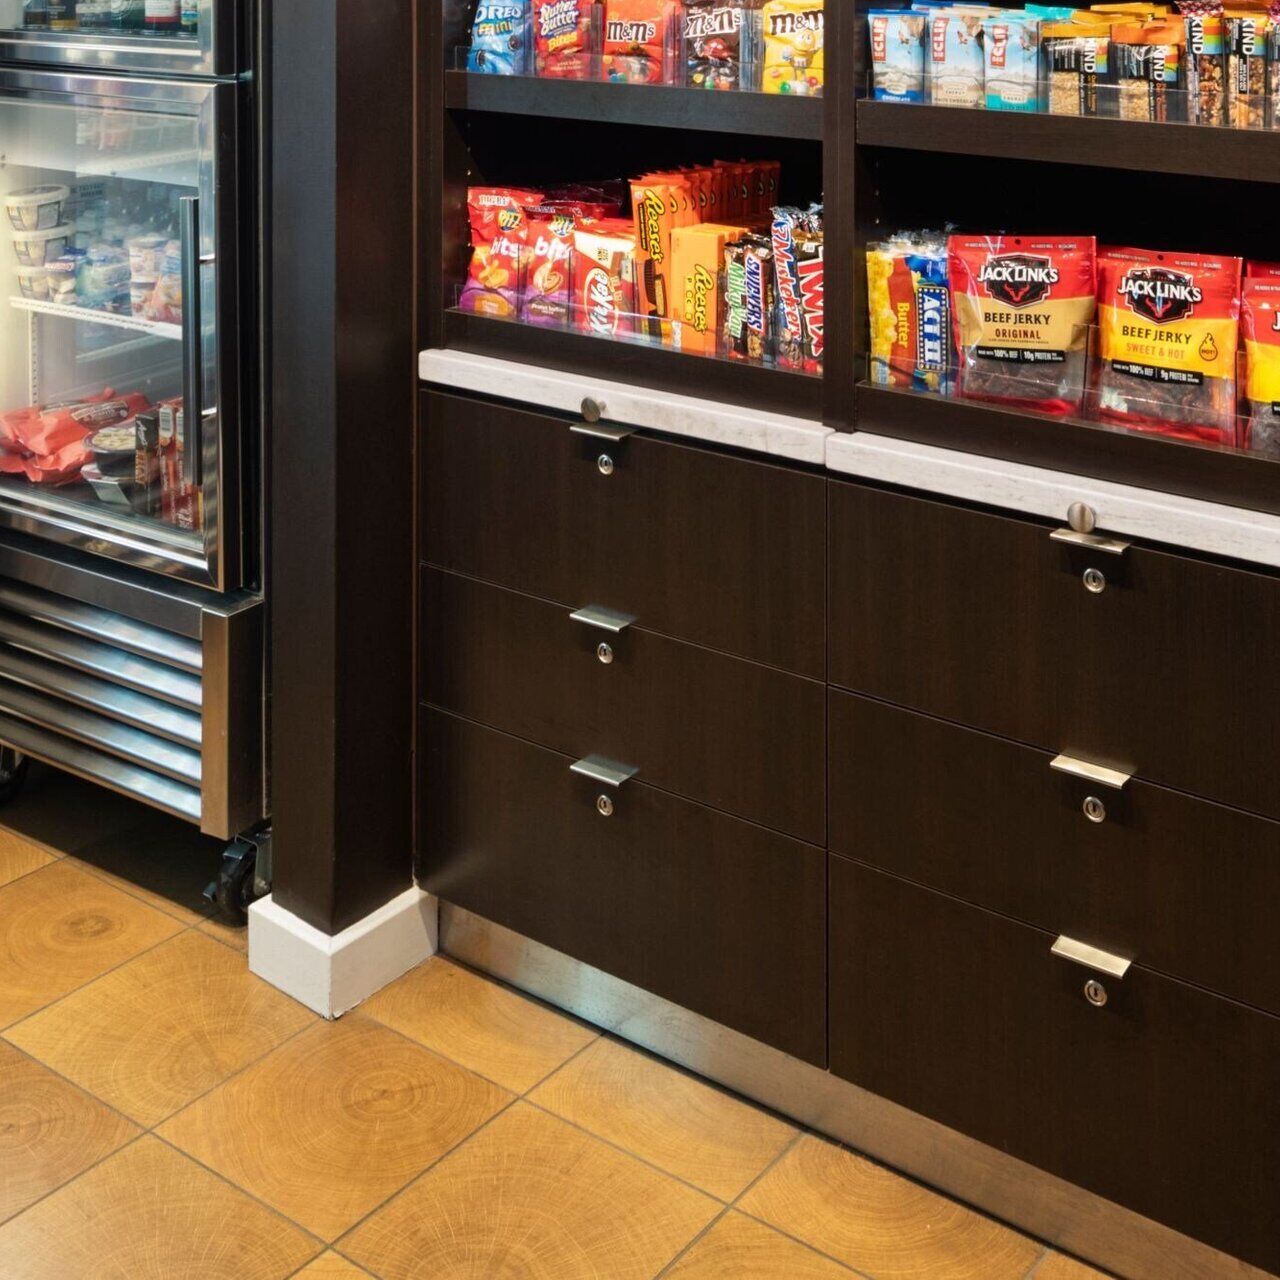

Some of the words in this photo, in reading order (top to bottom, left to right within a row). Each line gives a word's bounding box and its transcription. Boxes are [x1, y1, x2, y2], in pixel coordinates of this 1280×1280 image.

[475, 5, 522, 24] OREO
[539, 0, 578, 21] Nutter
[477, 21, 513, 36] mini
[539, 11, 579, 36] Butter
[1191, 16, 1204, 55] KIND
[1243, 18, 1256, 56] KIND
[1085, 39, 1097, 73] KIND
[1154, 45, 1165, 81] KIND
[644, 189, 665, 264] Reese's
[491, 237, 519, 256] bits
[534, 236, 573, 258] bits
[977, 265, 1014, 282] JACK
[1014, 265, 1059, 284] LINK'S
[694, 264, 714, 335] Reese's
[746, 254, 763, 333] SNICKERS
[773, 237, 803, 342] Musketeers
[1118, 277, 1155, 297] JACK
[1156, 281, 1202, 302] LINK'S
[897, 302, 910, 348] Butter
[984, 312, 1011, 323] BEEF
[1014, 314, 1051, 325] JERKY
[995, 328, 1041, 340] ORIGINAL
[1122, 325, 1152, 339] BEEF
[1154, 331, 1192, 345] JERKY
[1126, 343, 1156, 356] SWEET
[1168, 348, 1185, 359] HOT
